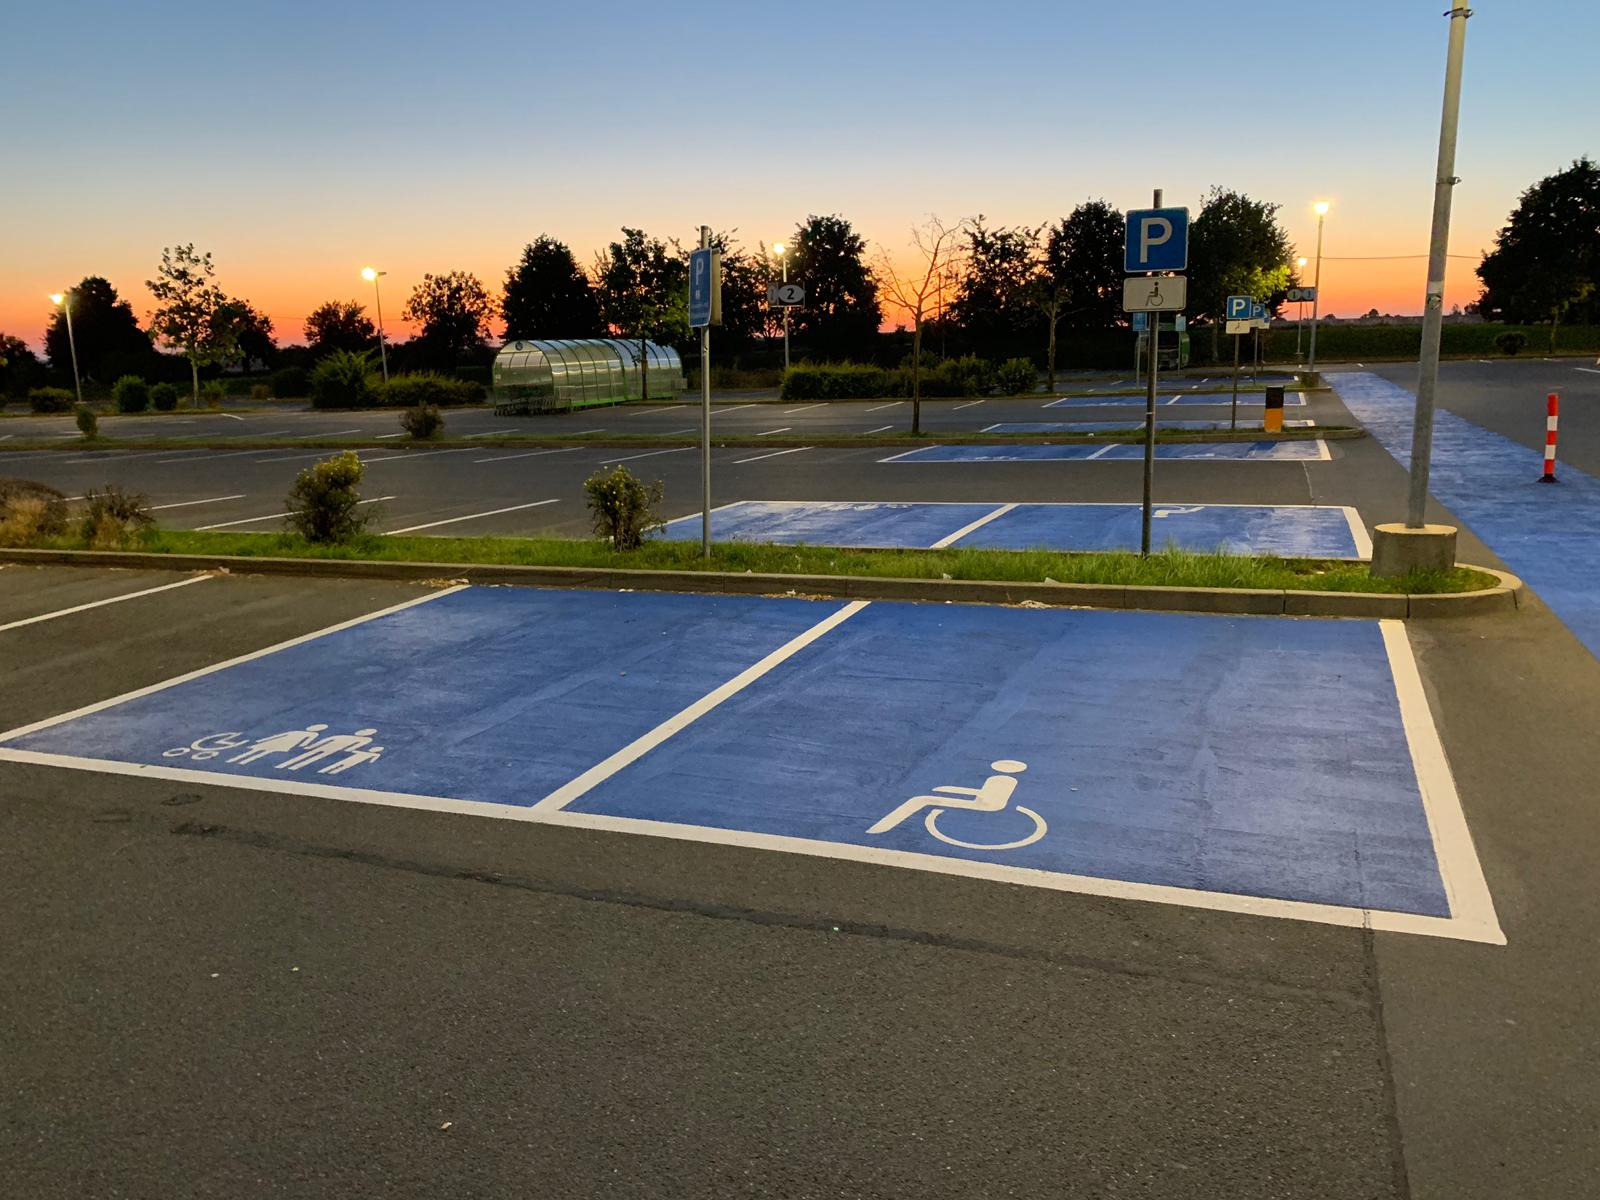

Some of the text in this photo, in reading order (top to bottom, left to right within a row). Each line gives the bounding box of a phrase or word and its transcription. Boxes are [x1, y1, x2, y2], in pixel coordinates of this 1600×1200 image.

[1140, 217, 1172, 263] P
[696, 257, 704, 285] P
[787, 287, 795, 300] 2
[1232, 299, 1245, 316] P
[1252, 305, 1261, 316] P
